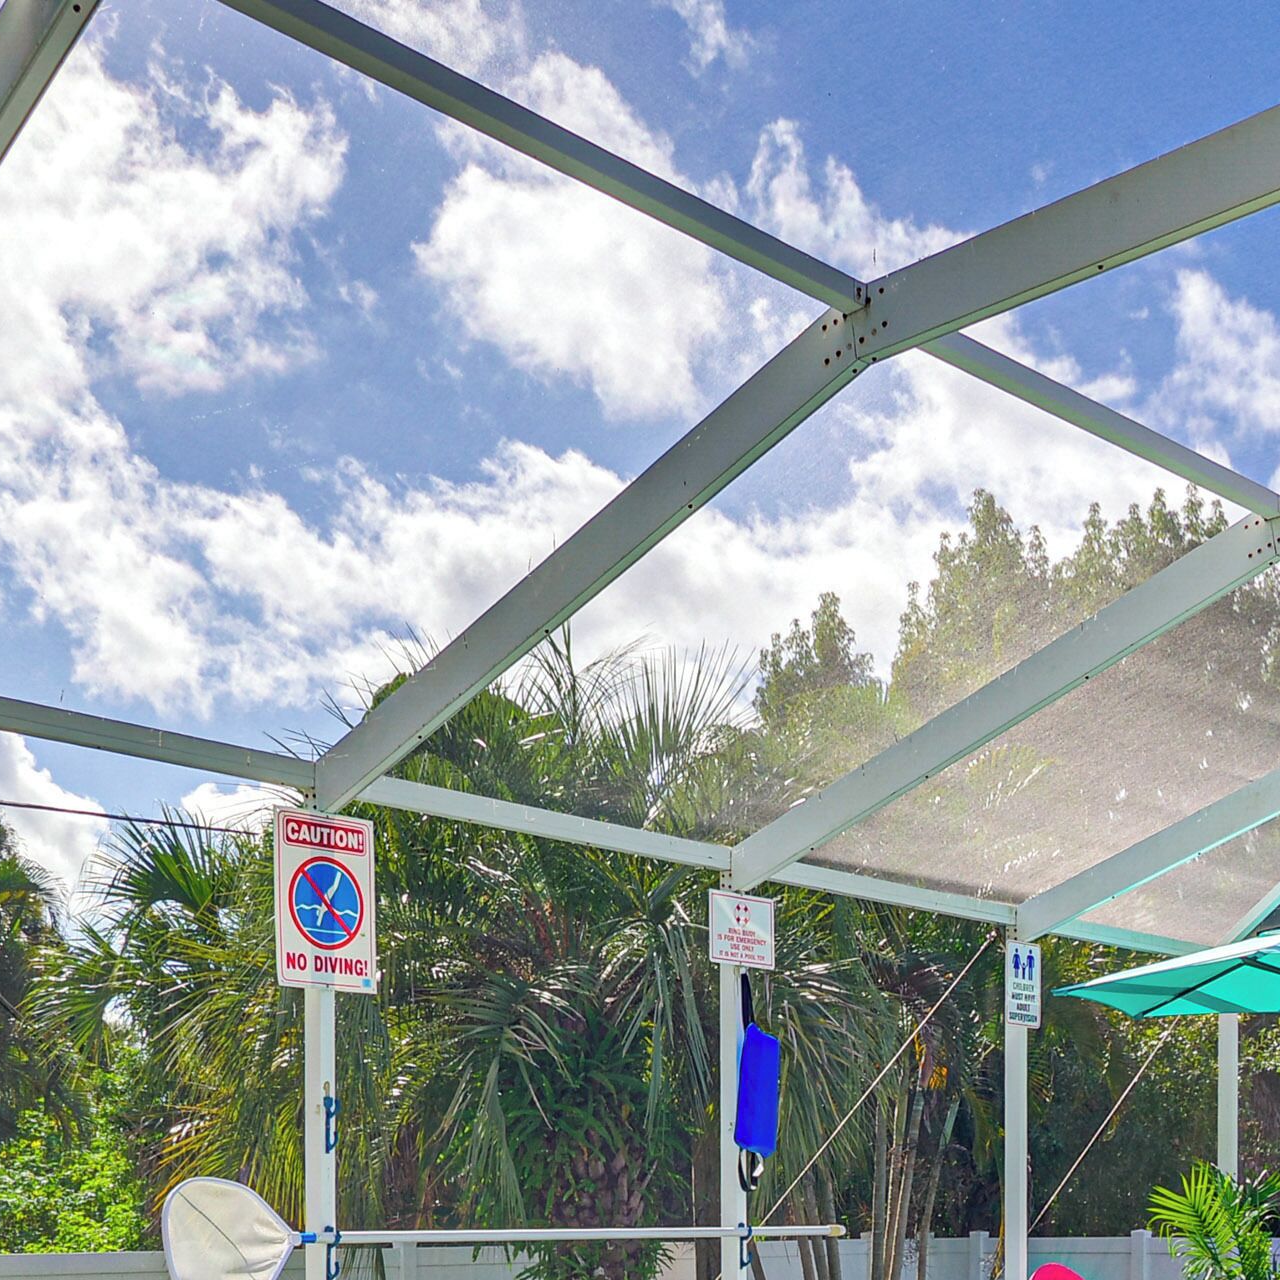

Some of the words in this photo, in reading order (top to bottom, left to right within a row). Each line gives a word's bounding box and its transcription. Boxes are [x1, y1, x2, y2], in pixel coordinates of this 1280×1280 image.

[286, 821, 364, 850] CAUTION!
[736, 936, 766, 945] EMERGENCY
[286, 951, 307, 971] NO
[314, 954, 368, 976] DIVING!
